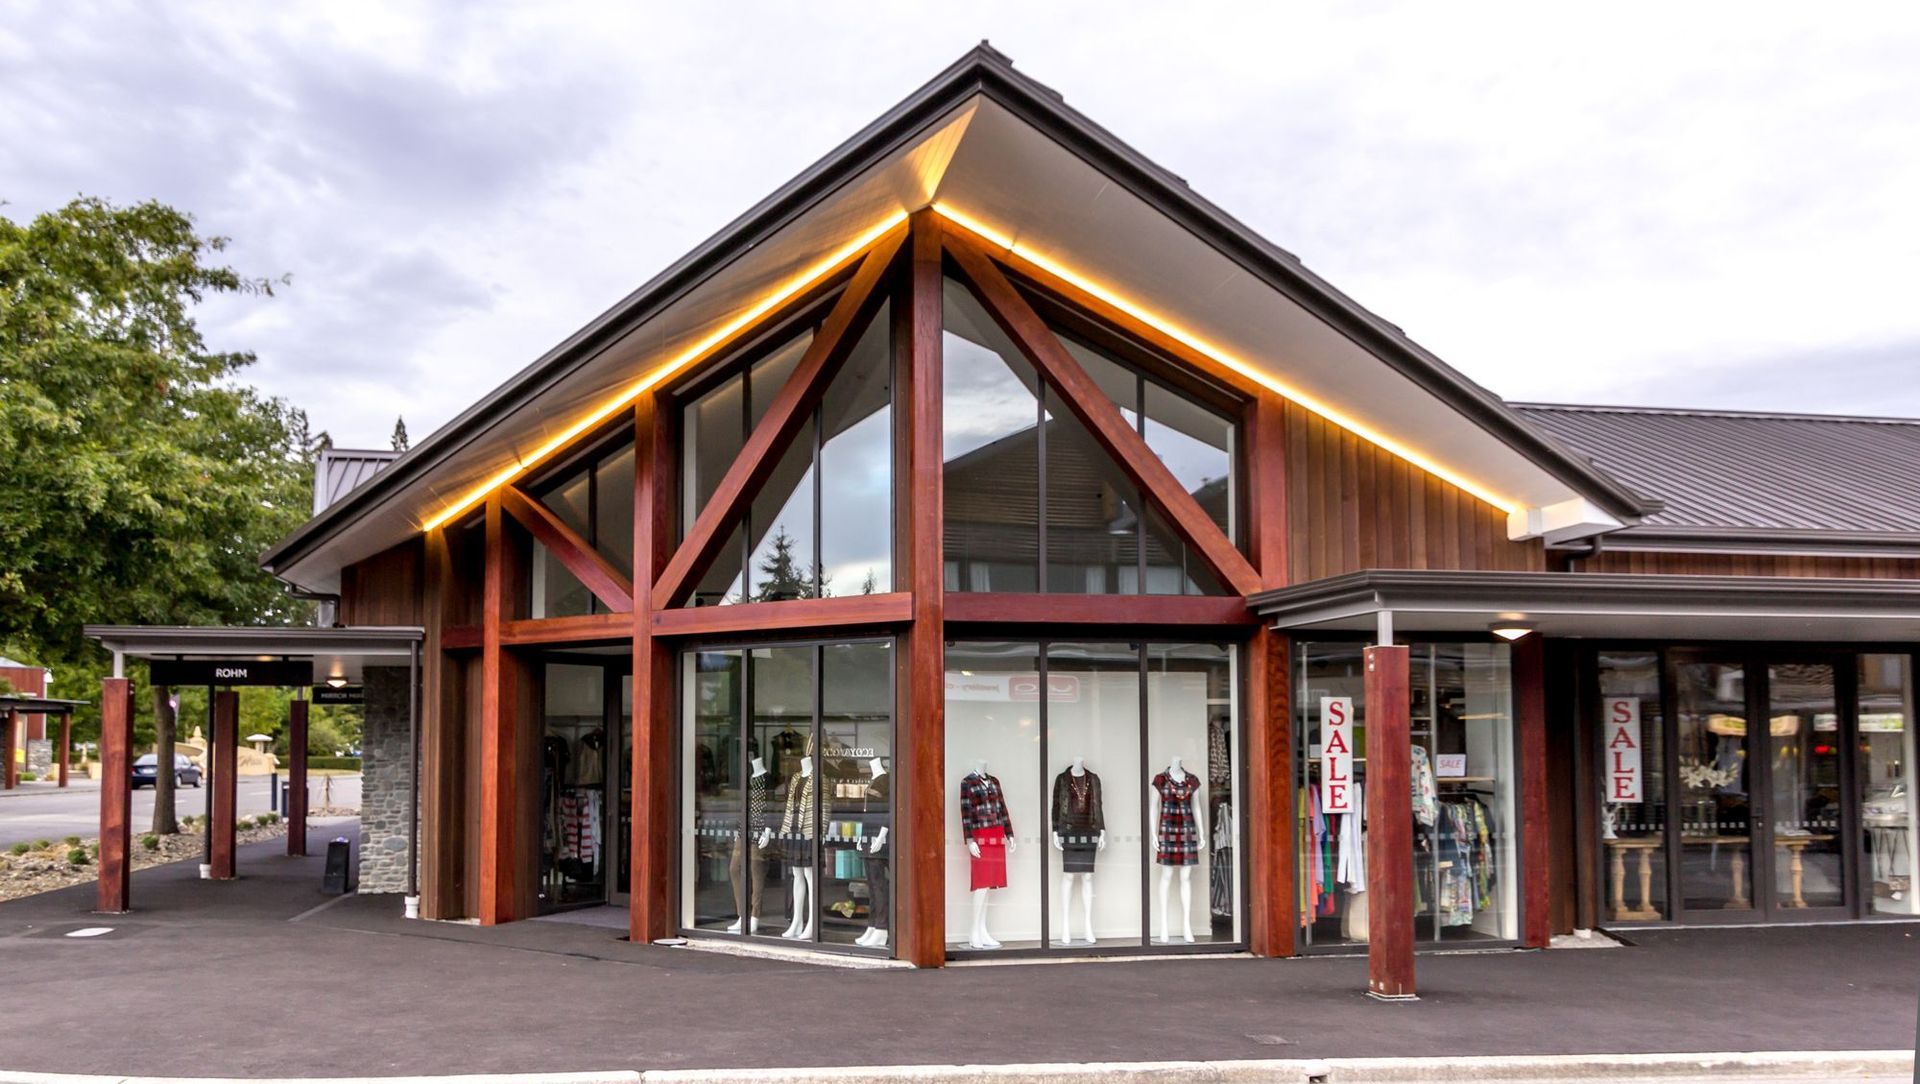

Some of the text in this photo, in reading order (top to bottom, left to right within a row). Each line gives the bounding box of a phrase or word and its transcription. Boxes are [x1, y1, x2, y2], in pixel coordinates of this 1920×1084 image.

[215, 667, 248, 678] ROHM
[1325, 701, 1349, 810] SALE
[1440, 759, 1462, 769] SALE
[1608, 701, 1636, 800] SALE
